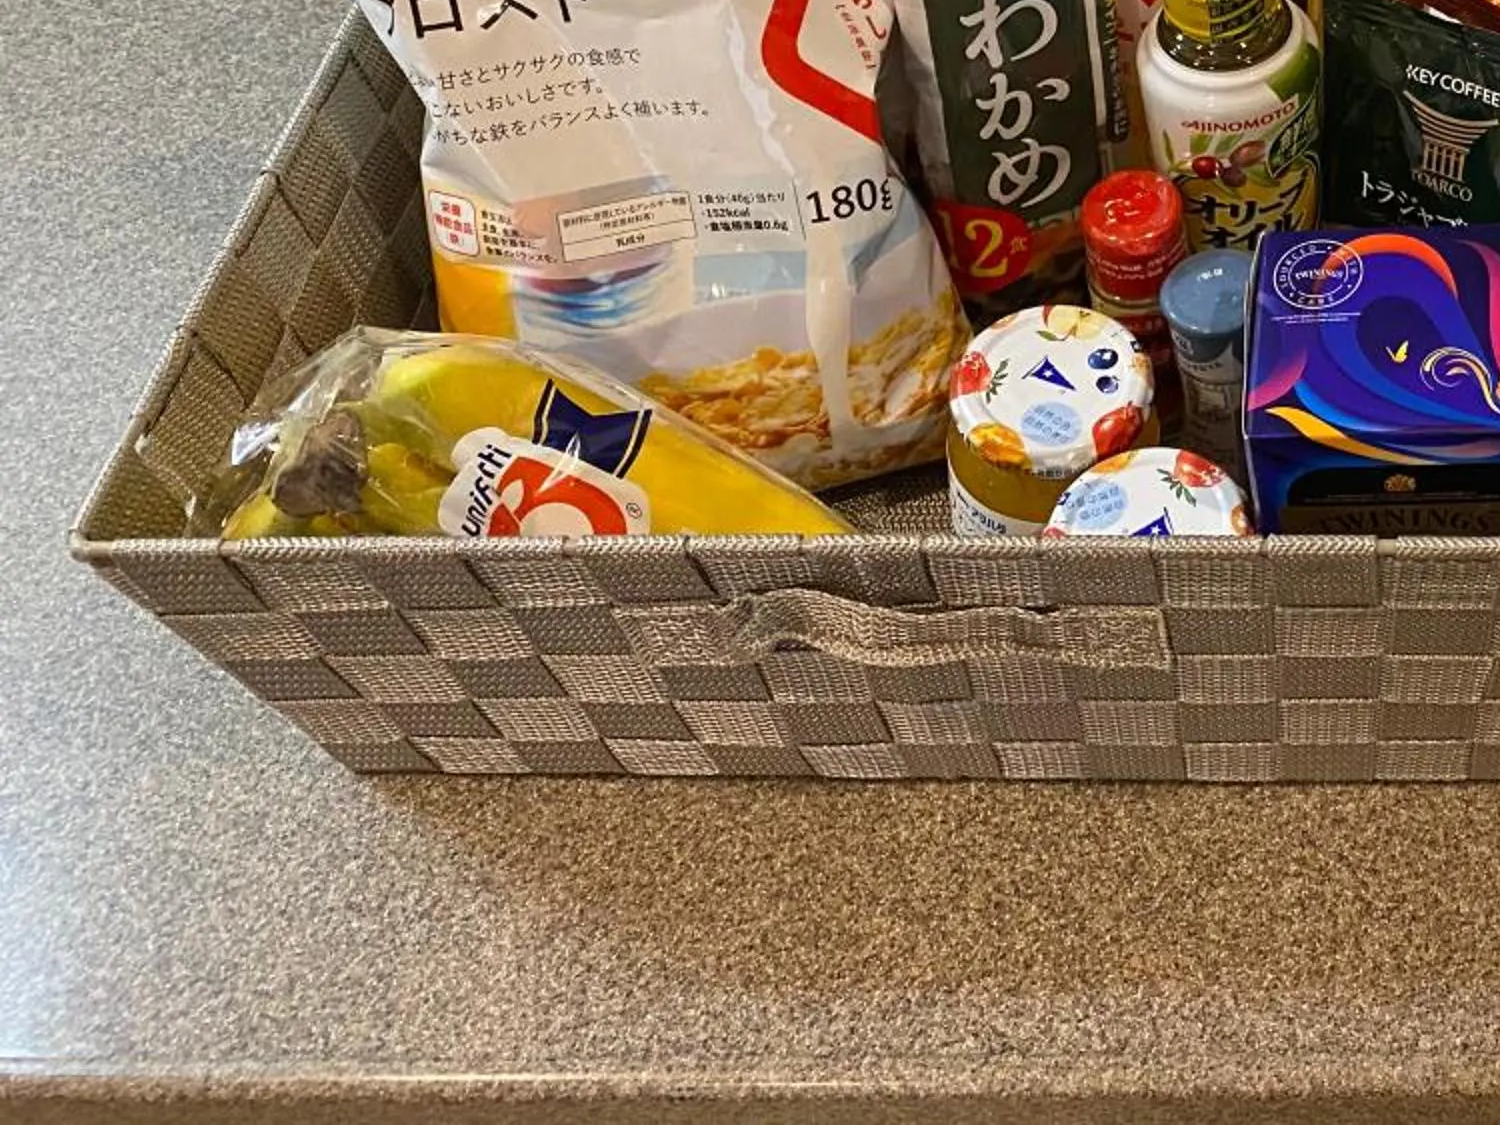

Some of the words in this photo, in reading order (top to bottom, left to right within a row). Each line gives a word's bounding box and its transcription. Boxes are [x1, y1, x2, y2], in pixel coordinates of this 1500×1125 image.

[409, 49, 641, 90] 甘さとサクサクの食感で
[1439, 75, 1500, 108] COFFEE
[806, 178, 893, 224] 180g
